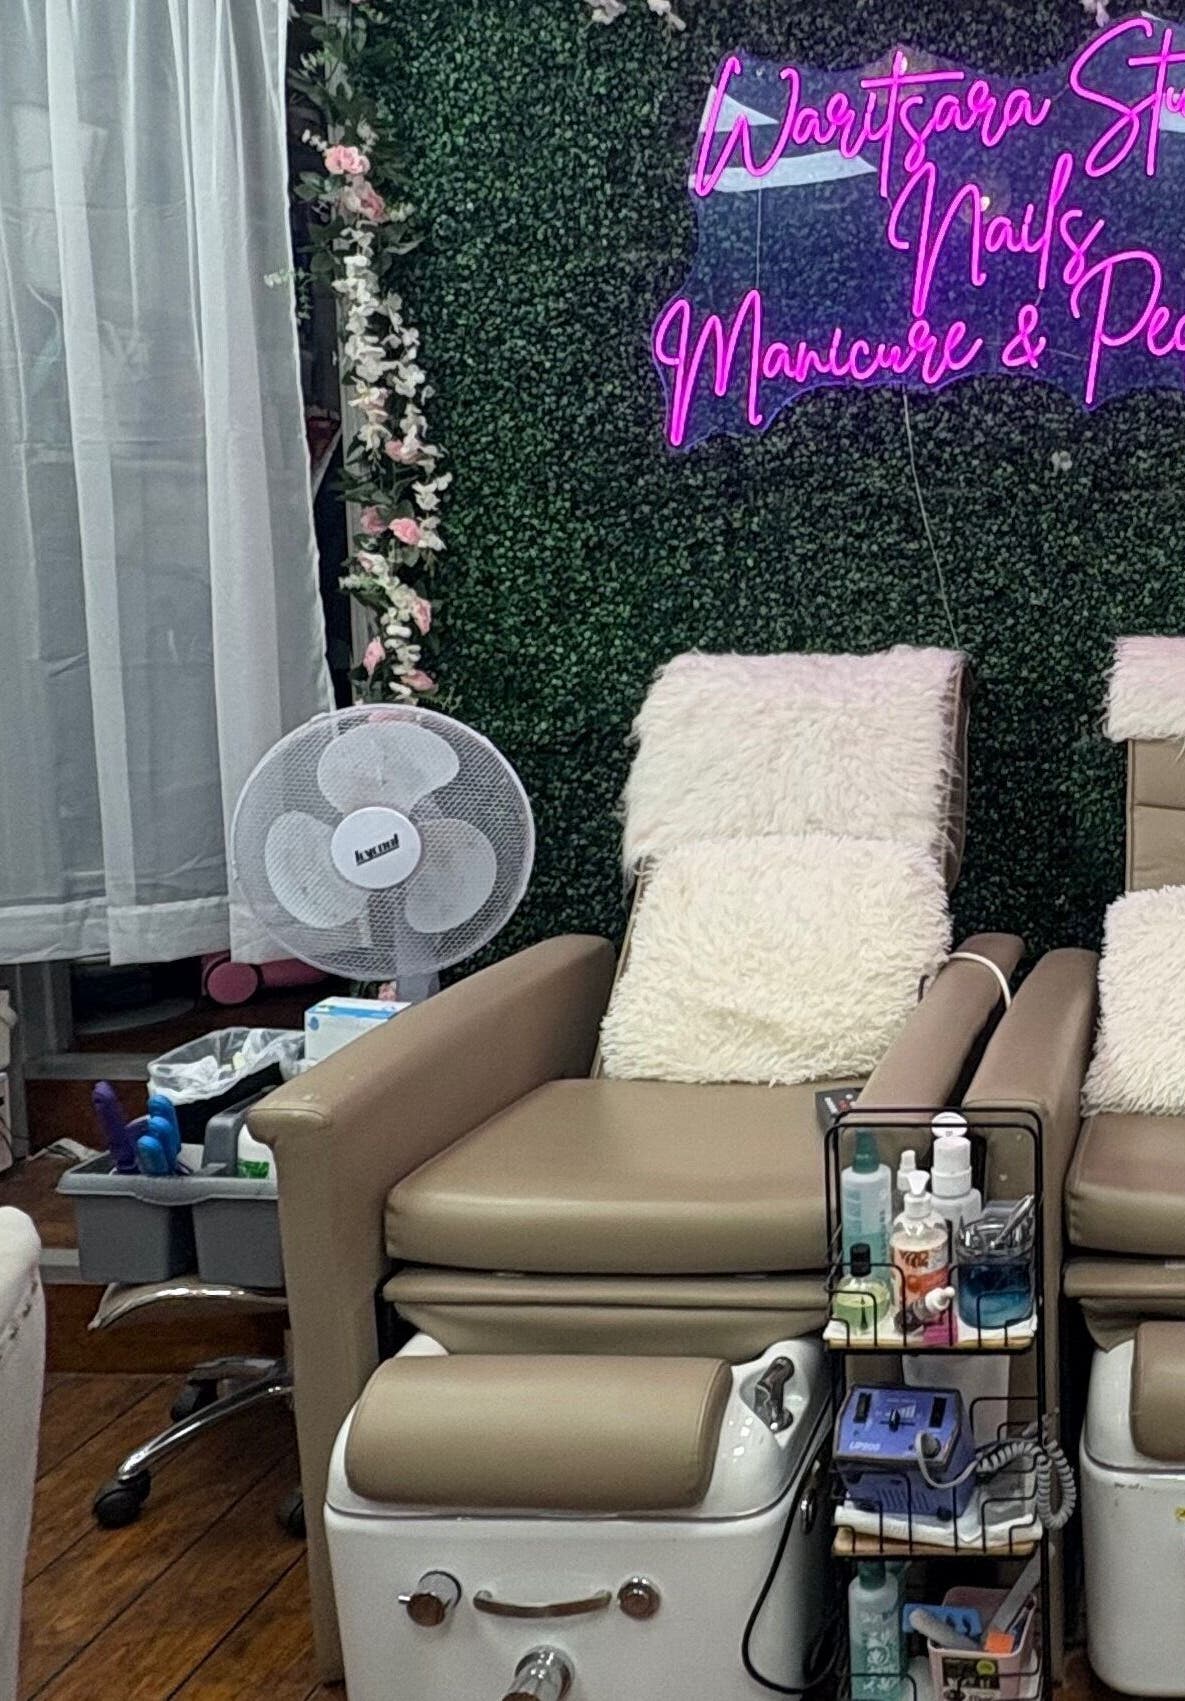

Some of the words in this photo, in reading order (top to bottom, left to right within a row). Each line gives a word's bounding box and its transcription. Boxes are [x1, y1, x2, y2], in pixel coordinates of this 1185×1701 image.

[695, 50, 1050, 197] Waritsara
[888, 153, 1104, 316] Nails
[654, 290, 983, 447] Manicure
[1001, 304, 1046, 368] &
